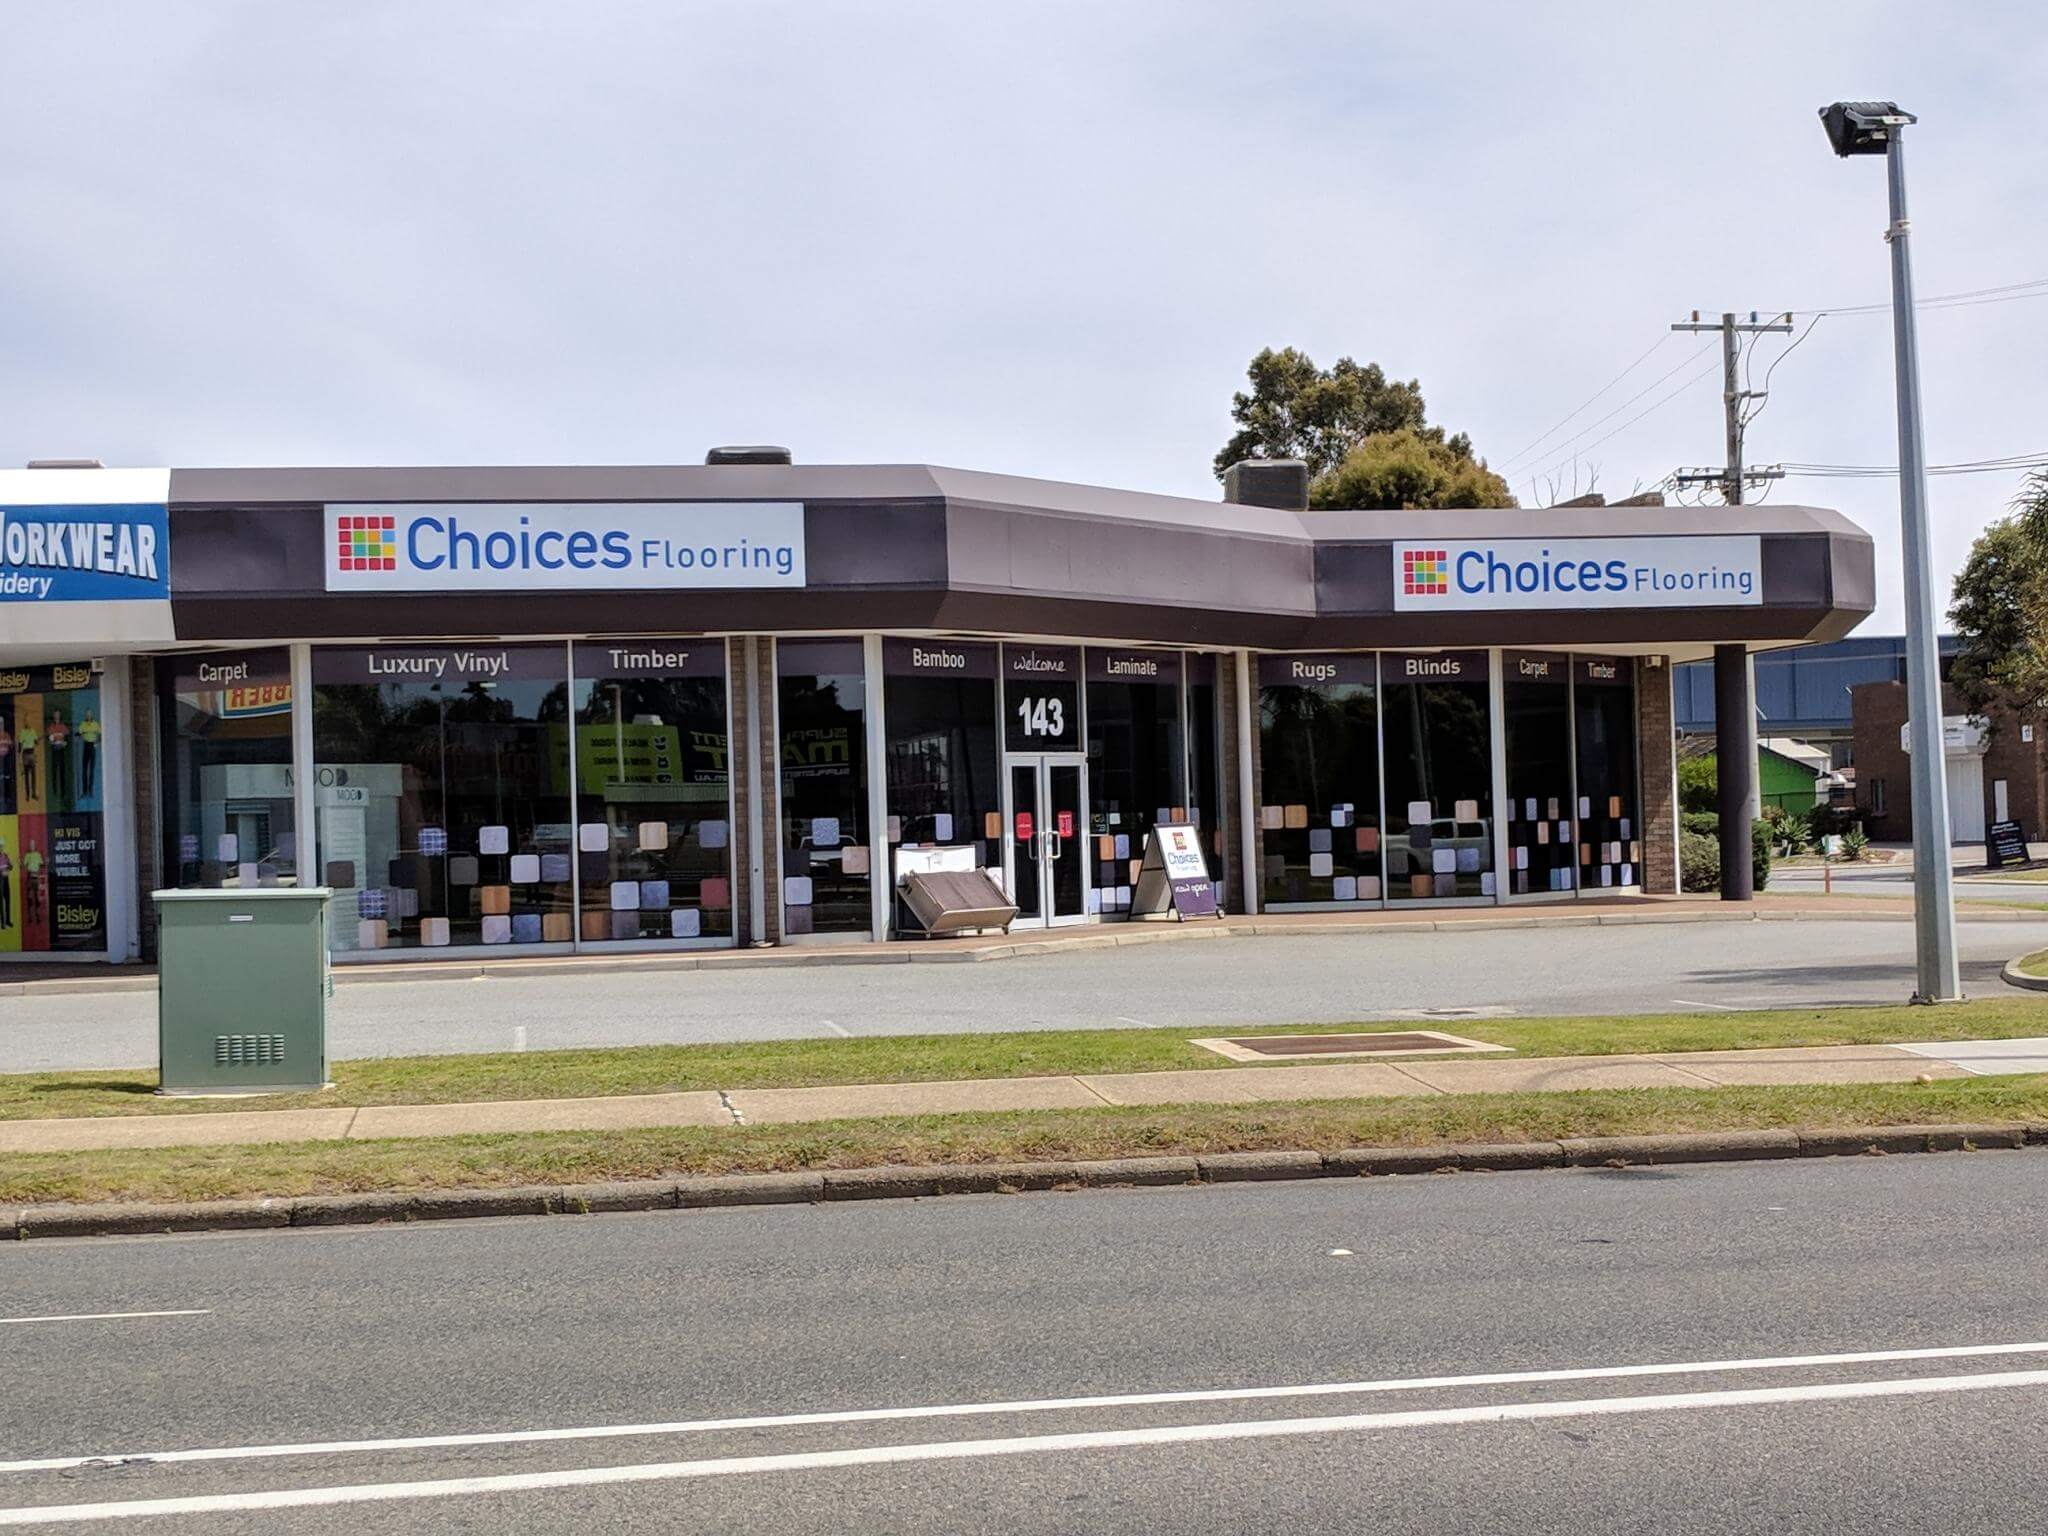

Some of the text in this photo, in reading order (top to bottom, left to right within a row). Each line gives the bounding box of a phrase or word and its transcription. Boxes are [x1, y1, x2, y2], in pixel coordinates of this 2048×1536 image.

[0, 512, 158, 581] ORKWEAR
[407, 516, 794, 575] Choices Flooring
[1456, 549, 1753, 595] Choices Flooring
[368, 651, 509, 679] Luxury Vinyl
[609, 648, 689, 669] Timber
[912, 647, 966, 669] Bamboo
[1013, 650, 1067, 673] welcome
[1106, 657, 1157, 676] Laminate
[1405, 658, 1461, 676] Blinds
[1519, 658, 1549, 678] Carpet
[0, 671, 30, 691] isley
[53, 666, 91, 685] Bisley
[200, 661, 249, 685] Carpet
[1291, 660, 1337, 683] Rugs
[1588, 662, 1616, 679] Timber
[1018, 697, 1064, 737] 143
[57, 904, 99, 926] Bisley
